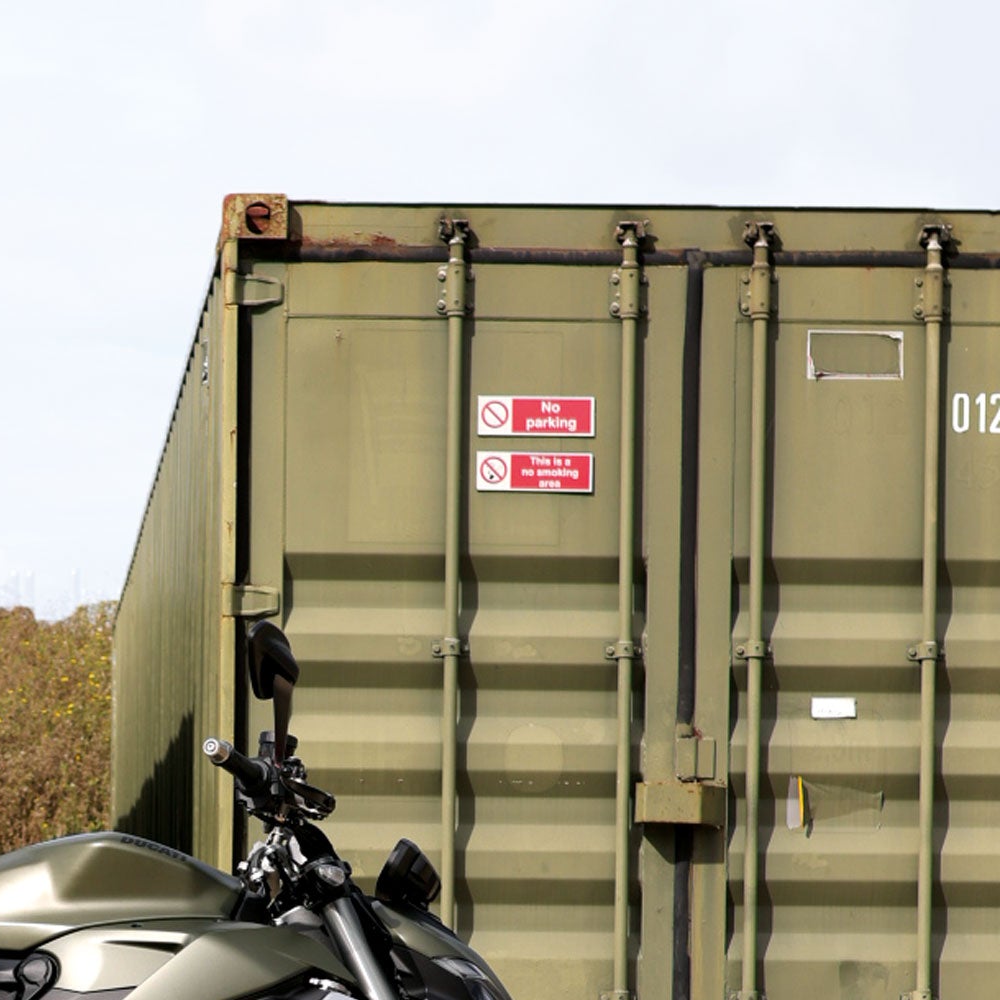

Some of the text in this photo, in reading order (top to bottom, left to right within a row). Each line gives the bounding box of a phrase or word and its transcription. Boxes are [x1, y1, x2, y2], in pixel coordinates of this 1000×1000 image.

[541, 401, 561, 413] No
[526, 416, 577, 432] parking
[529, 456, 571, 466] This is a
[521, 468, 579, 480] no smoking
[539, 480, 561, 488] area
[120, 836, 187, 862] DUCATI
